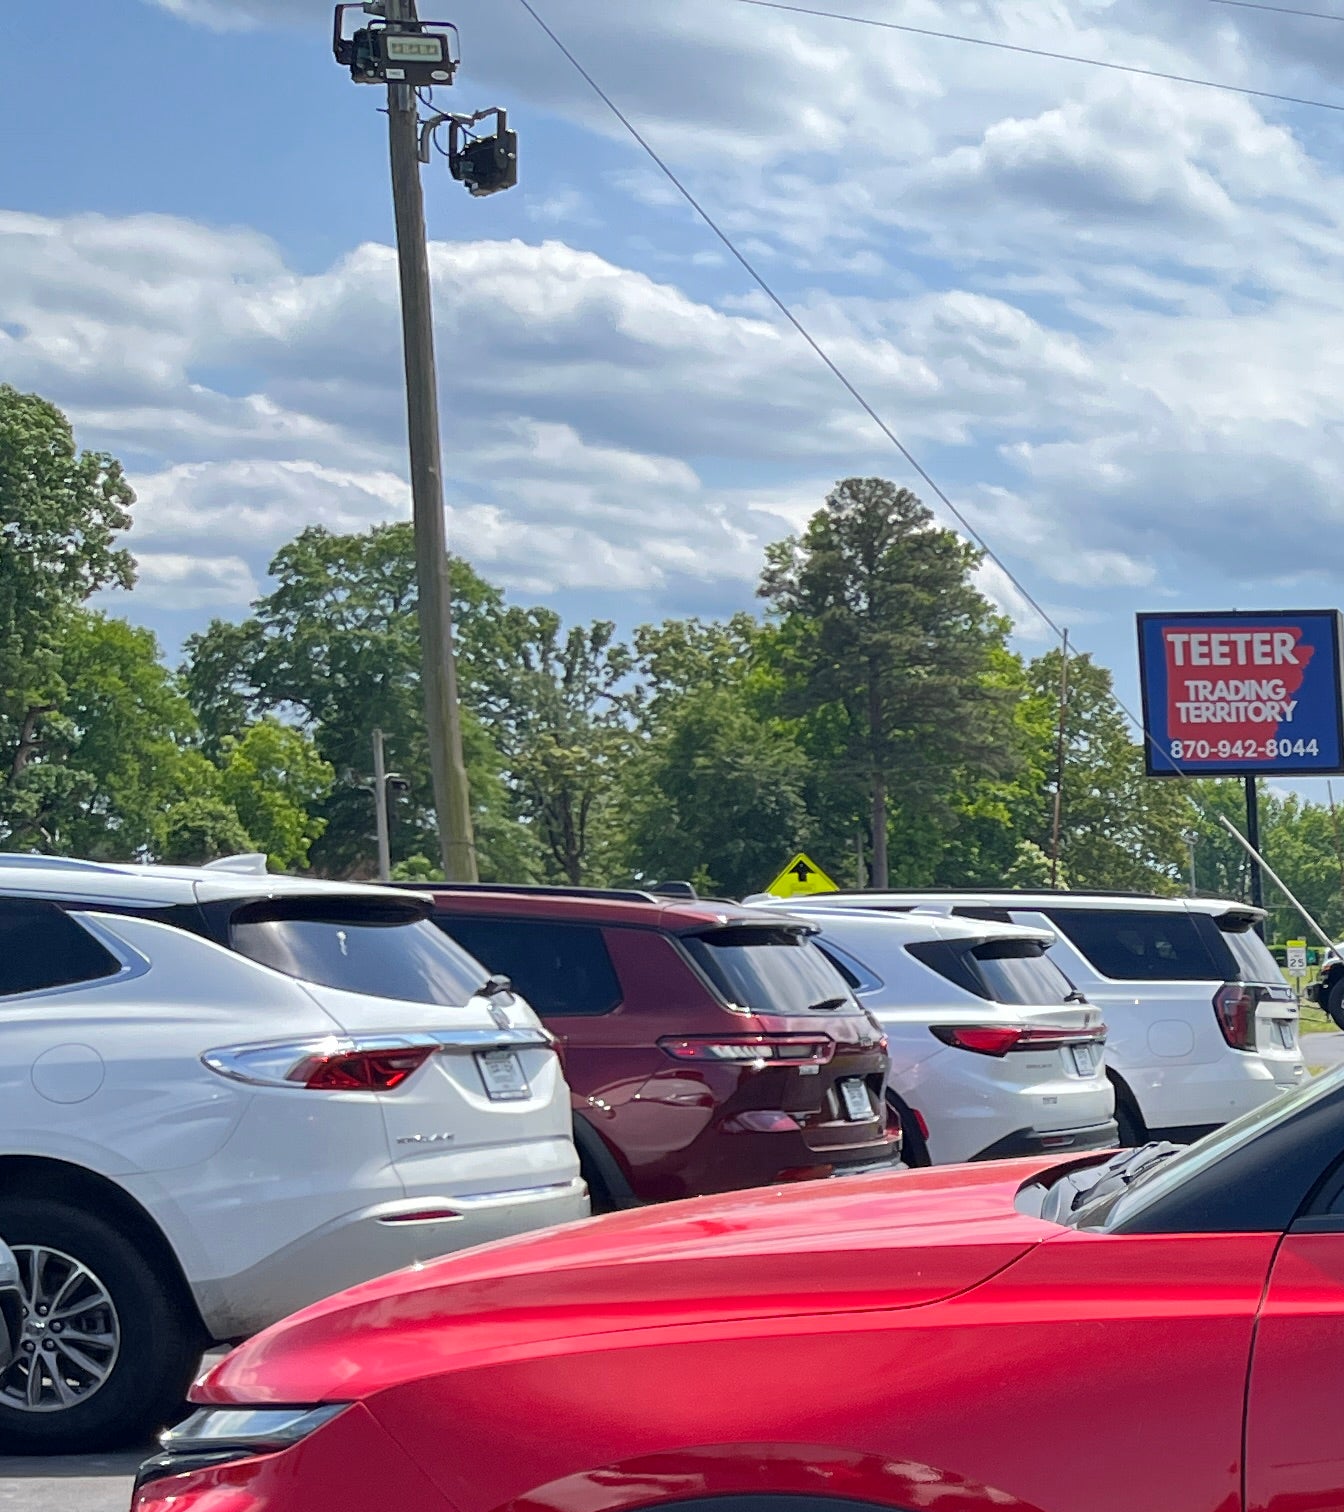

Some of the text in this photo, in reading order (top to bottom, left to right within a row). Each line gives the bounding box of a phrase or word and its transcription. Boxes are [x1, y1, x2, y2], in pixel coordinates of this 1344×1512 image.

[1166, 632, 1299, 666] TEETER
[1184, 679, 1286, 701] TRADING
[1176, 701, 1298, 723] TERRITORY
[1170, 738, 1319, 759] 870-942-8044
[1290, 958, 1304, 968] 25
